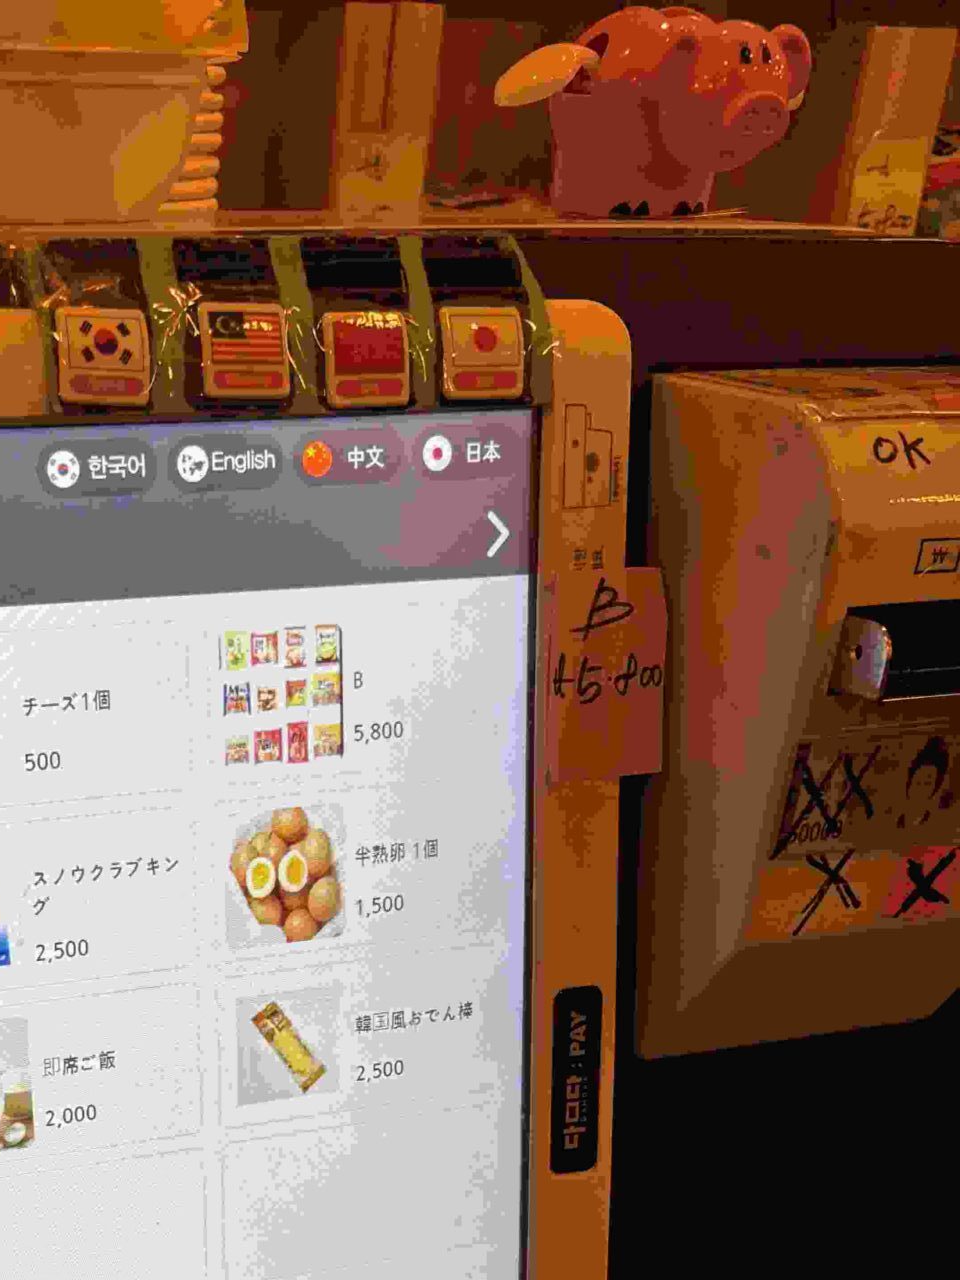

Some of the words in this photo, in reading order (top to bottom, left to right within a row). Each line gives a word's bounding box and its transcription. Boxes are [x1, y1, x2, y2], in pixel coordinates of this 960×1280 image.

[211, 448, 276, 473] English
[347, 446, 385, 470] 中文
[465, 440, 501, 463] 日本
[872, 430, 932, 470] OK
[88, 454, 147, 480] 한국어
[569, 577, 635, 643] B
[353, 671, 363, 690] B
[353, 721, 405, 745] 5,800
[24, 751, 61, 772] 500
[33, 857, 181, 887] スノウクラブキン
[32, 897, 50, 916] グ
[354, 894, 405, 919] 1,500
[35, 940, 90, 966] 2,500
[354, 1000, 474, 1034] 韓国風おでん棒
[568, 1009, 588, 1058] PAY
[41, 1051, 116, 1077] 即席ご飯
[355, 1059, 405, 1083] 2,500
[45, 1104, 97, 1129] 2,000
